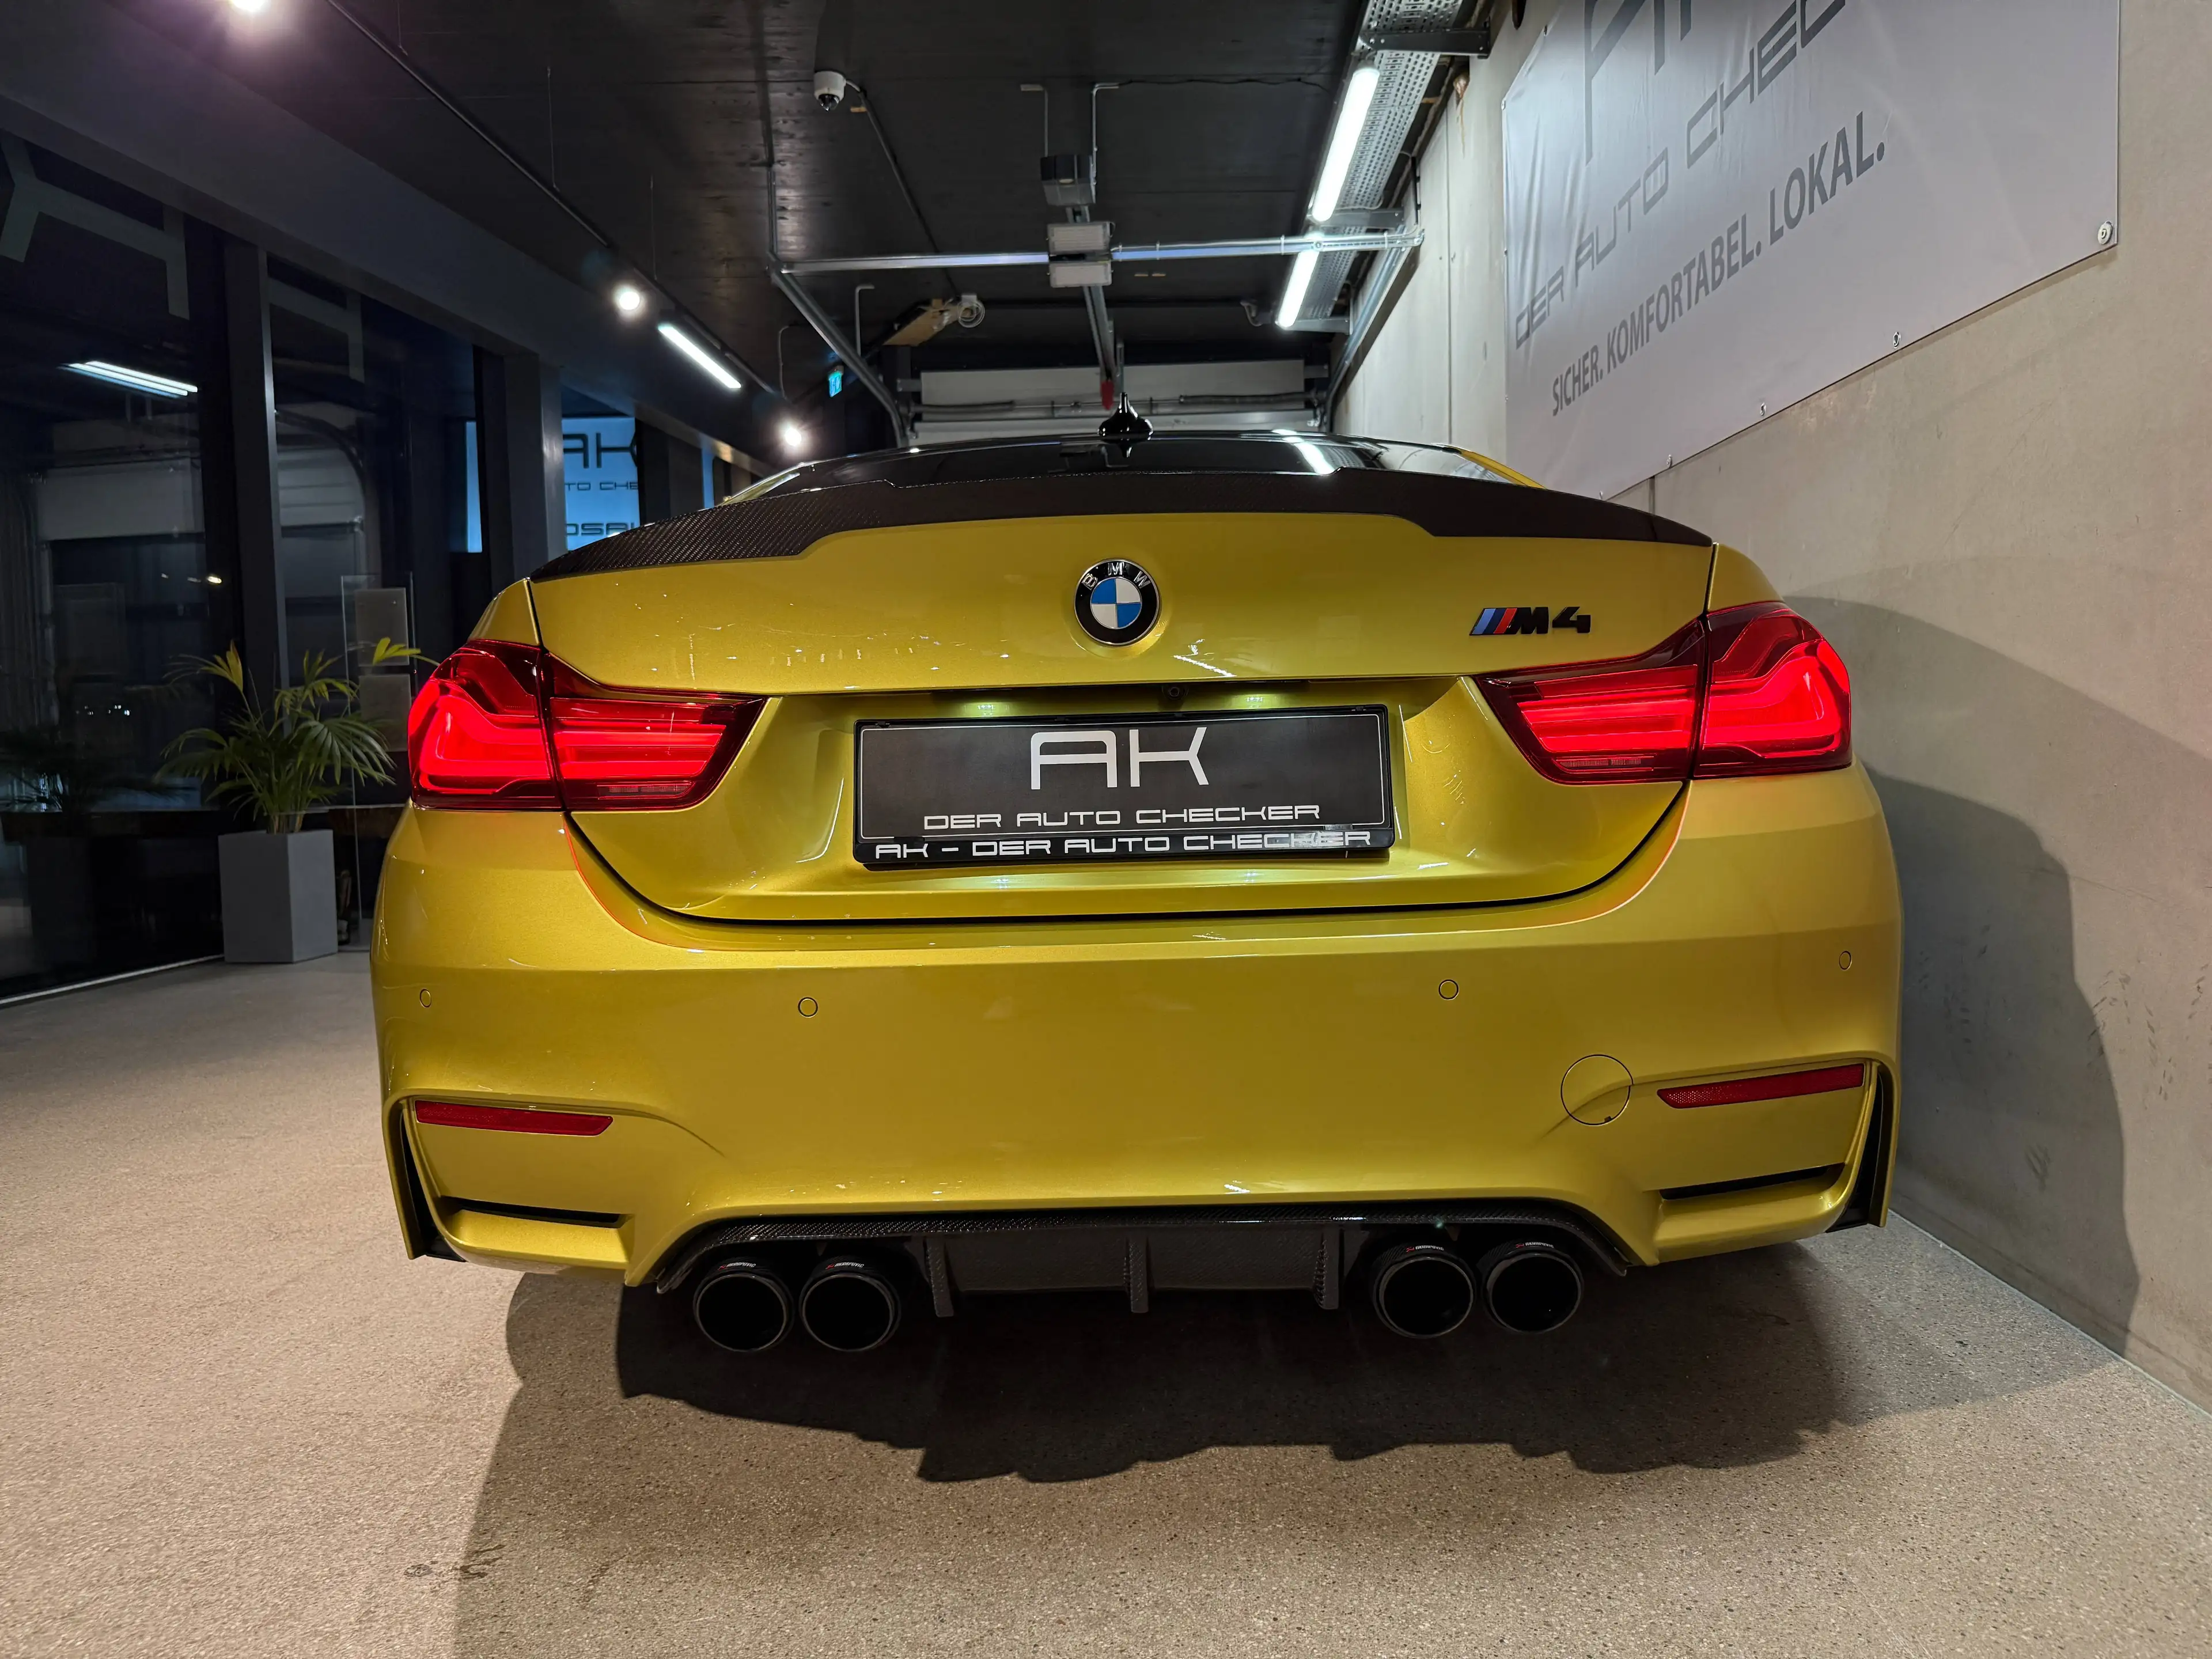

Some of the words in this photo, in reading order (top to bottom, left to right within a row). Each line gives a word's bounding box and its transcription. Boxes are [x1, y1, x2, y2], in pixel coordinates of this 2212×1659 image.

[1517, 266, 1564, 349] DER
[1575, 147, 1669, 287] AUTO
[1687, 0, 1844, 169] CHEC
[1552, 344, 1603, 416] SICHER.
[1607, 213, 1762, 374] KOMFORTABEL.
[1770, 111, 1885, 245] LOKAL.
[565, 482, 591, 490] TO
[1082, 562, 1151, 590] BMW
[1503, 607, 1591, 635] M4
[1031, 727, 1209, 790] AK
[924, 813, 1002, 830] DER
[1017, 810, 1120, 827] AUTO
[1136, 805, 1320, 824] CHECKER
[876, 843, 928, 859] AK
[972, 840, 1051, 857] DER
[1065, 836, 1170, 854] AUTO
[1184, 831, 1371, 850] CHECKER
